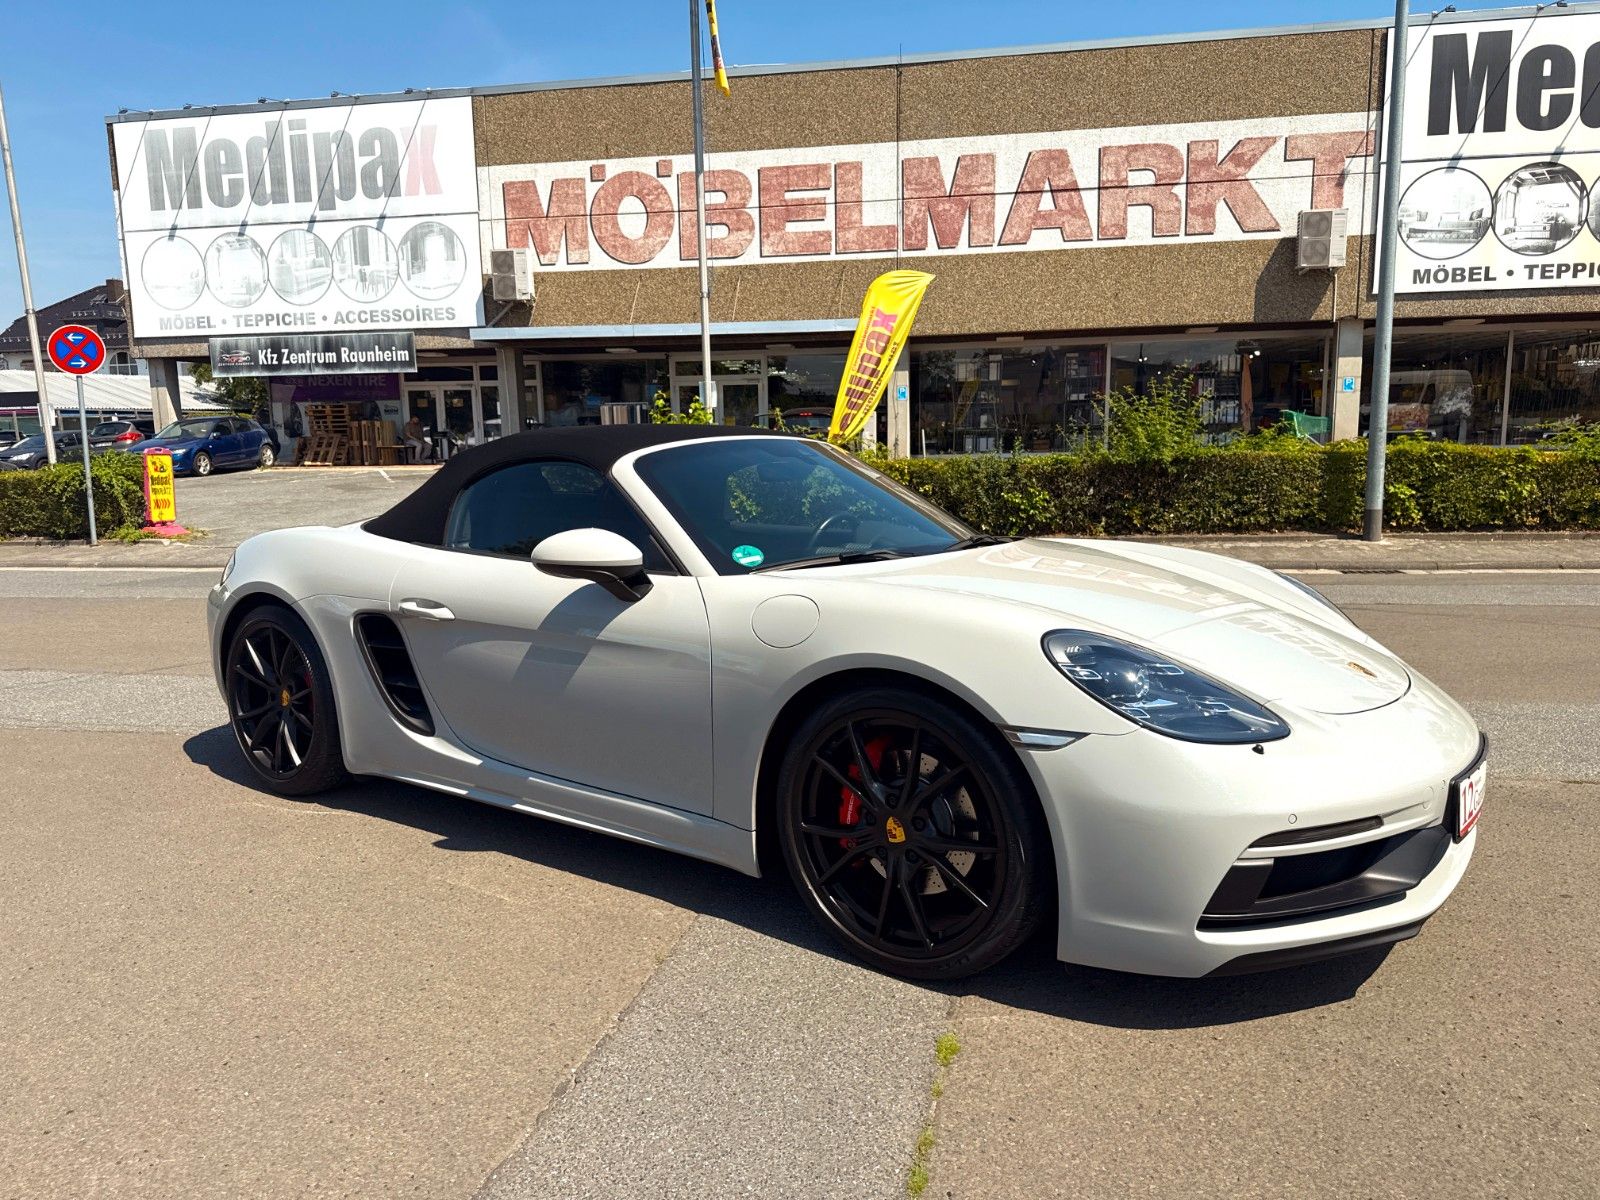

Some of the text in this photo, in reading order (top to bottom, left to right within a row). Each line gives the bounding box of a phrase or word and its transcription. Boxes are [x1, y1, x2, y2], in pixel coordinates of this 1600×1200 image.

[143, 118, 443, 212] Medipax
[1412, 262, 1600, 285] MÖBEL TEPPI
[159, 314, 217, 331] MÖBEL
[232, 311, 316, 328] TEPPICHE
[258, 345, 409, 365] Kfz Zentrum Raunheim
[308, 375, 352, 387] NEXEN
[354, 374, 387, 386] TIRE
